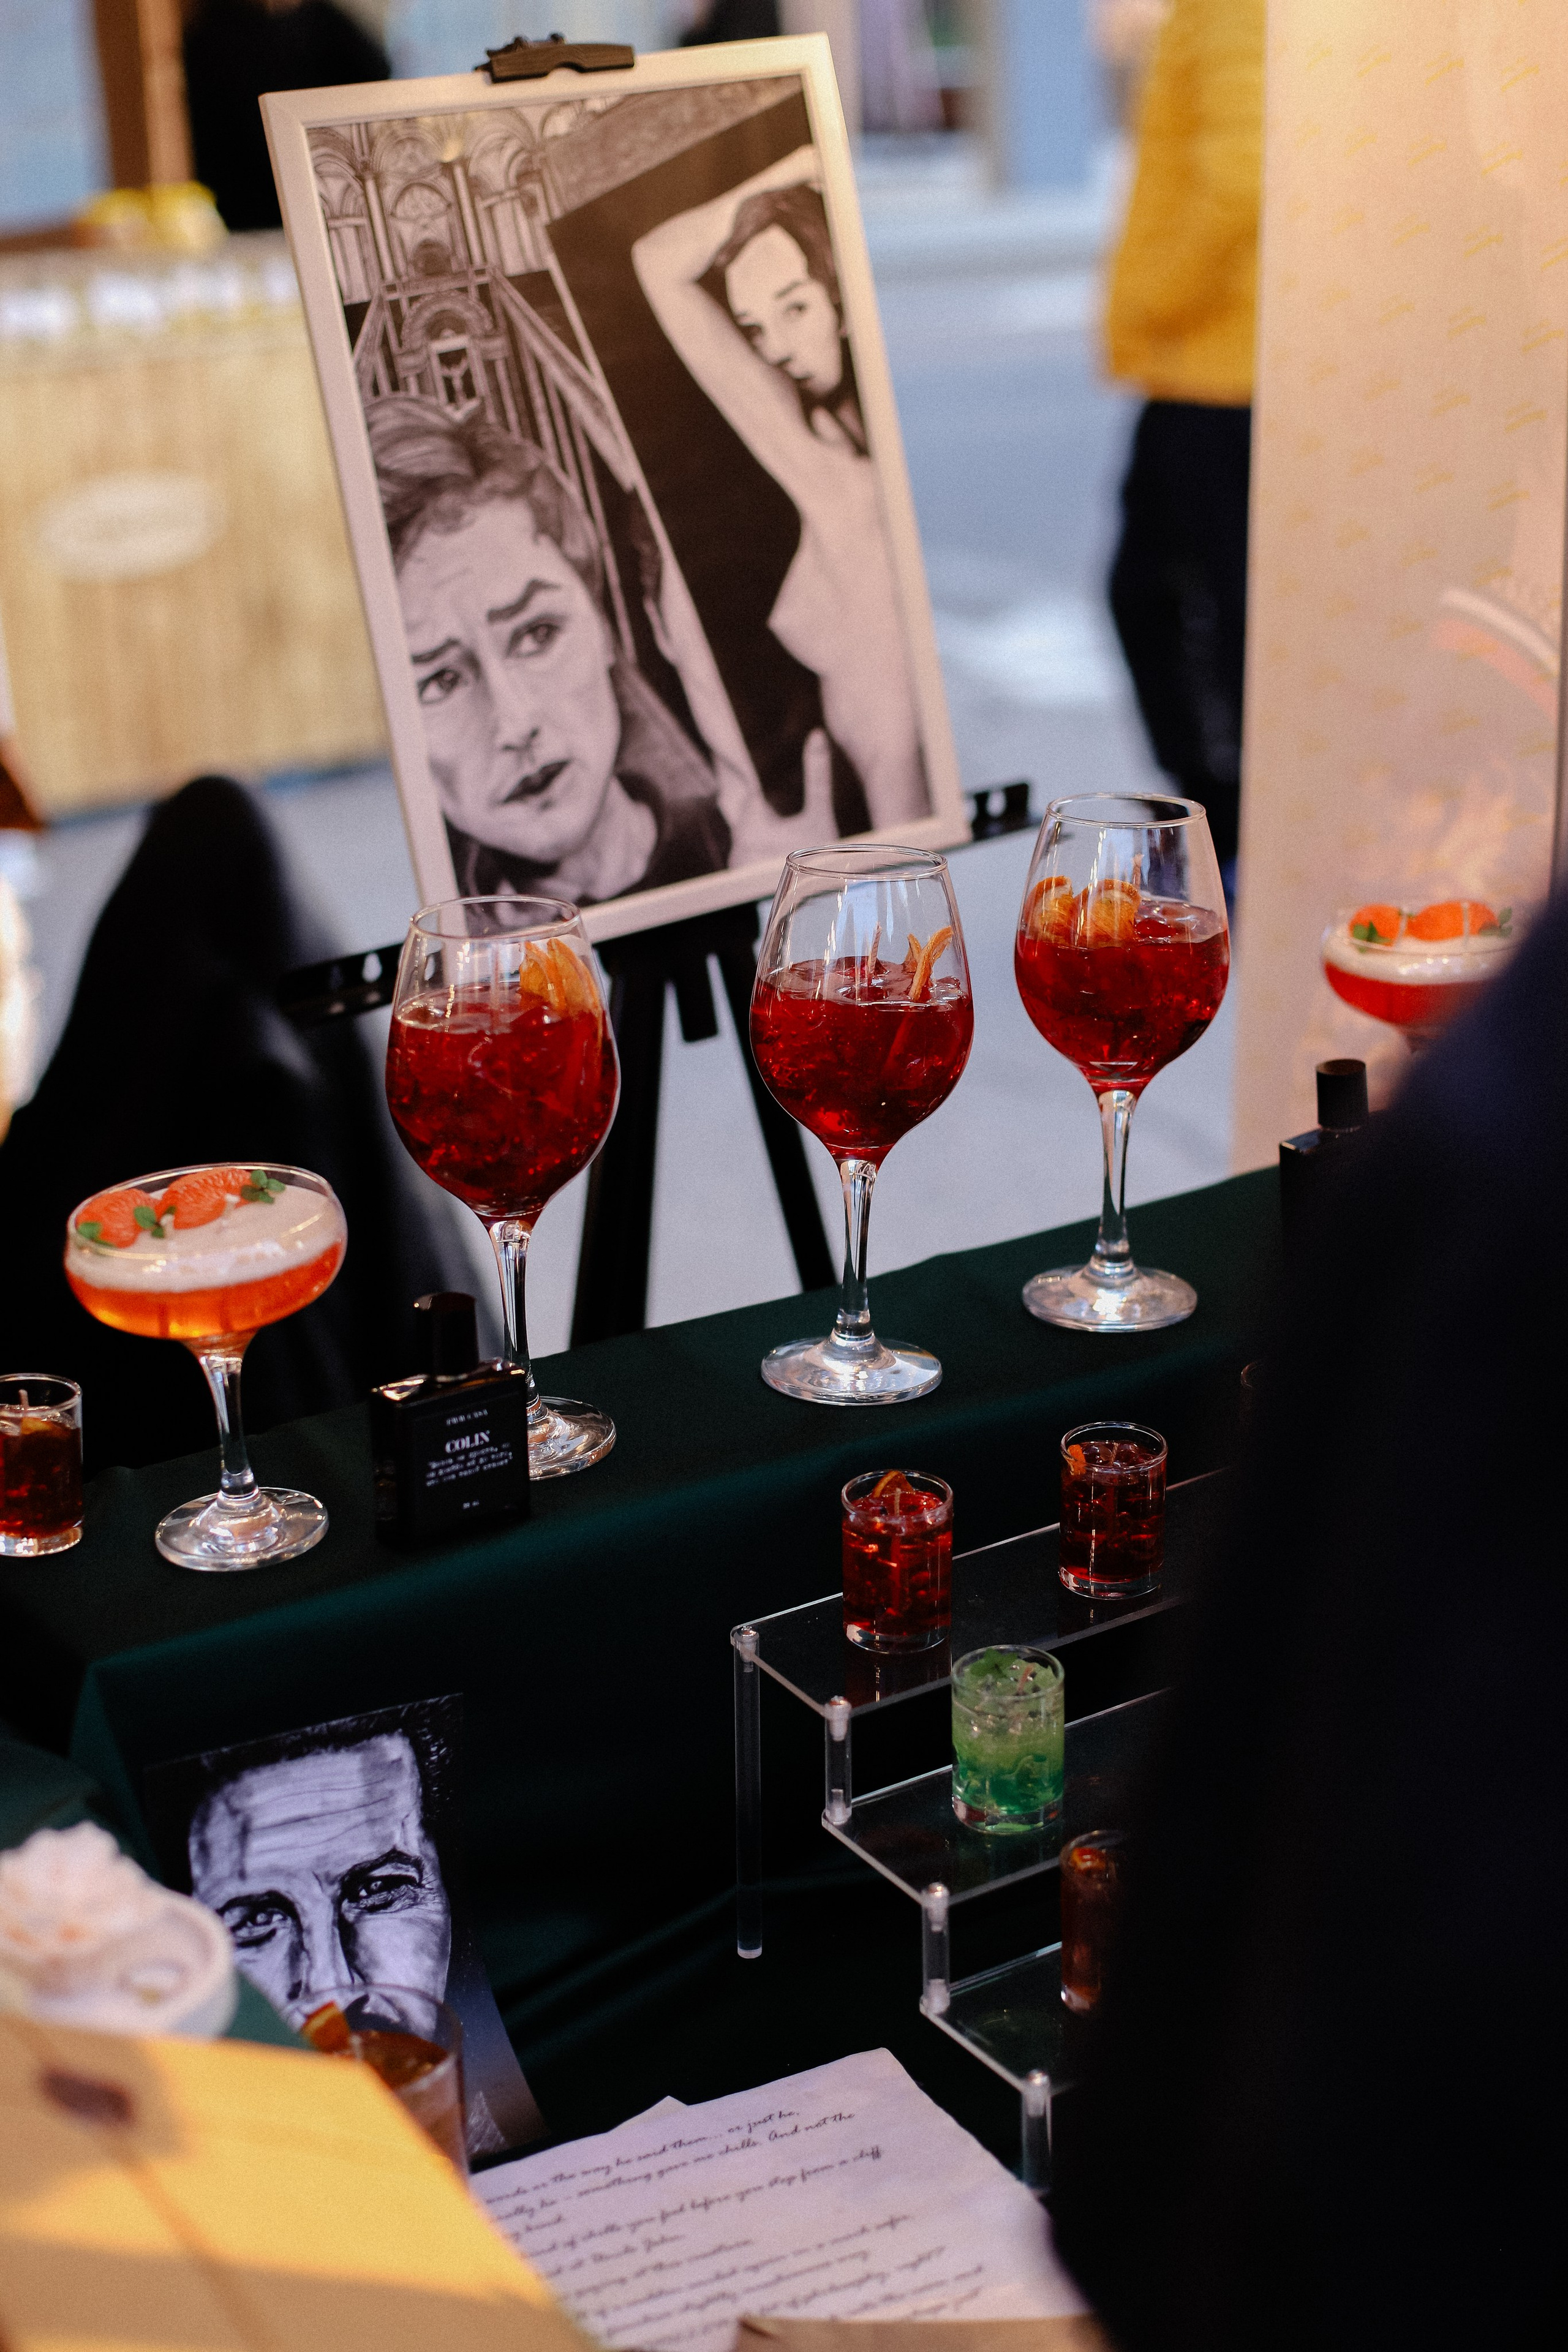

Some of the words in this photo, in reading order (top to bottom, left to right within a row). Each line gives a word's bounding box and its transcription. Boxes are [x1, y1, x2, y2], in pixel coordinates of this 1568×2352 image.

[578, 2173, 652, 2198] something
[768, 2124, 801, 2141] And
[804, 2116, 830, 2131] not
[830, 2112, 856, 2123] the
[581, 2165, 611, 2176] way
[637, 2144, 668, 2161] said
[747, 2113, 775, 2134] just
[690, 2195, 731, 2213] before
[800, 2165, 835, 2184] from
